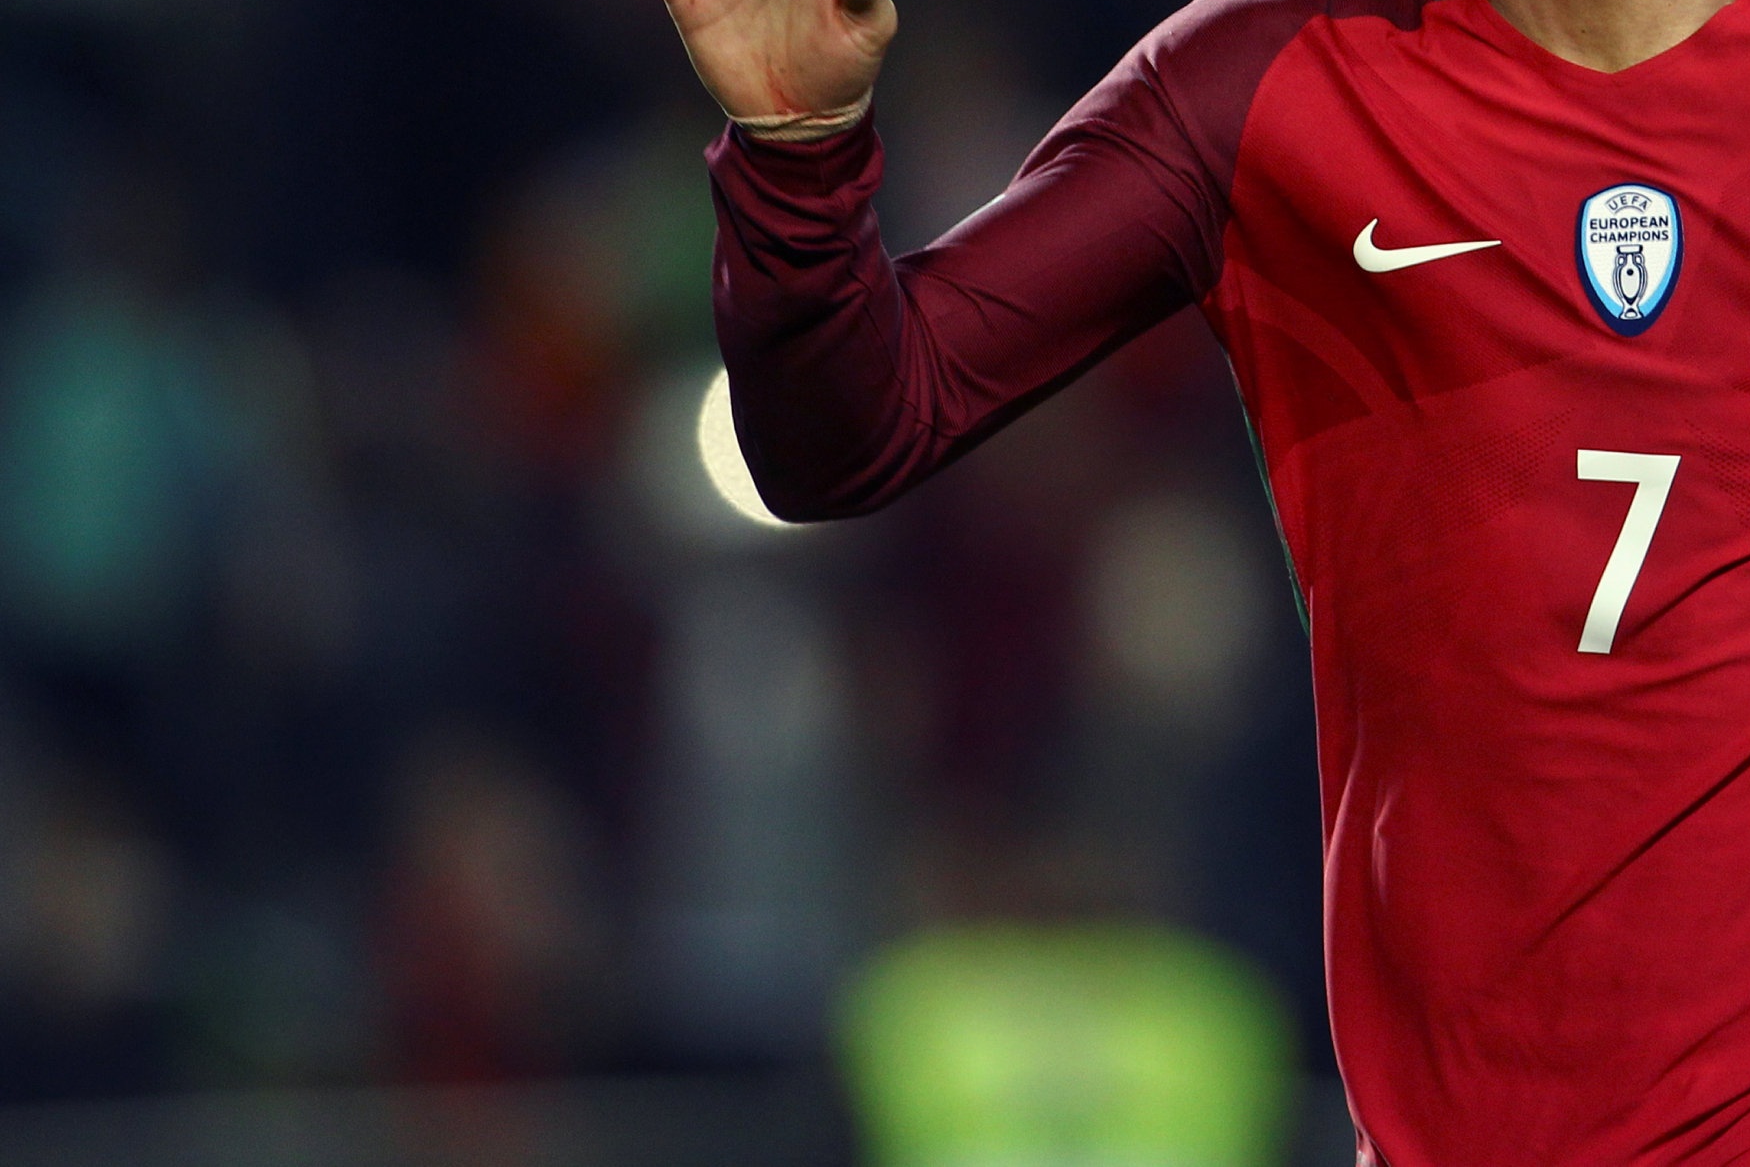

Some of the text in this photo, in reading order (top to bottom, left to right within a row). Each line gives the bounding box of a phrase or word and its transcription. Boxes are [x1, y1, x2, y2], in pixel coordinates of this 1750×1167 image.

[1608, 195, 1648, 211] UEFA
[1589, 215, 1669, 230] EUROPEAN
[1590, 230, 1670, 243] CHAMPIONS
[1577, 449, 1681, 654] 7
